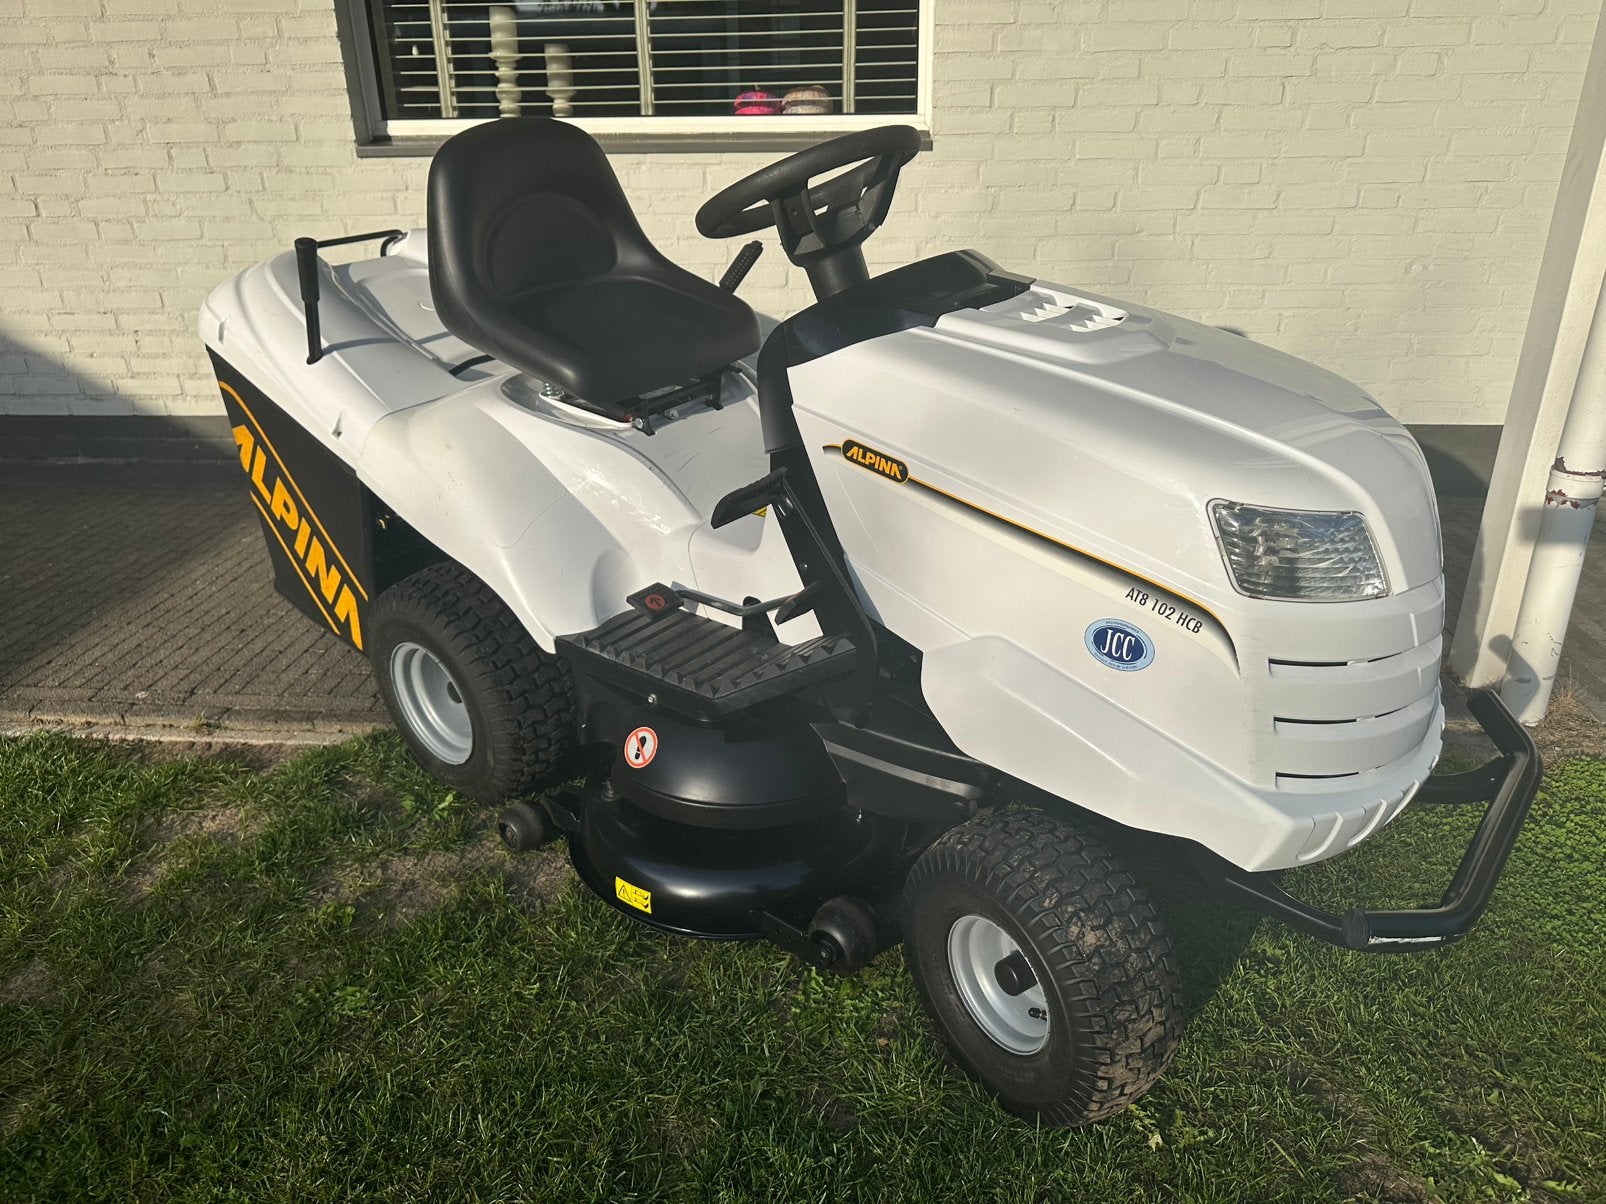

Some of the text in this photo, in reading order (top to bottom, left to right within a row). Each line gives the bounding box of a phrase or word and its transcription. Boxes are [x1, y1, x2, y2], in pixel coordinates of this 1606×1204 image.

[846, 446, 902, 479] ALPINA
[231, 424, 363, 650] ALPINA
[1125, 587, 1203, 634] AT8 102 HCB
[1100, 629, 1136, 661] JCC
